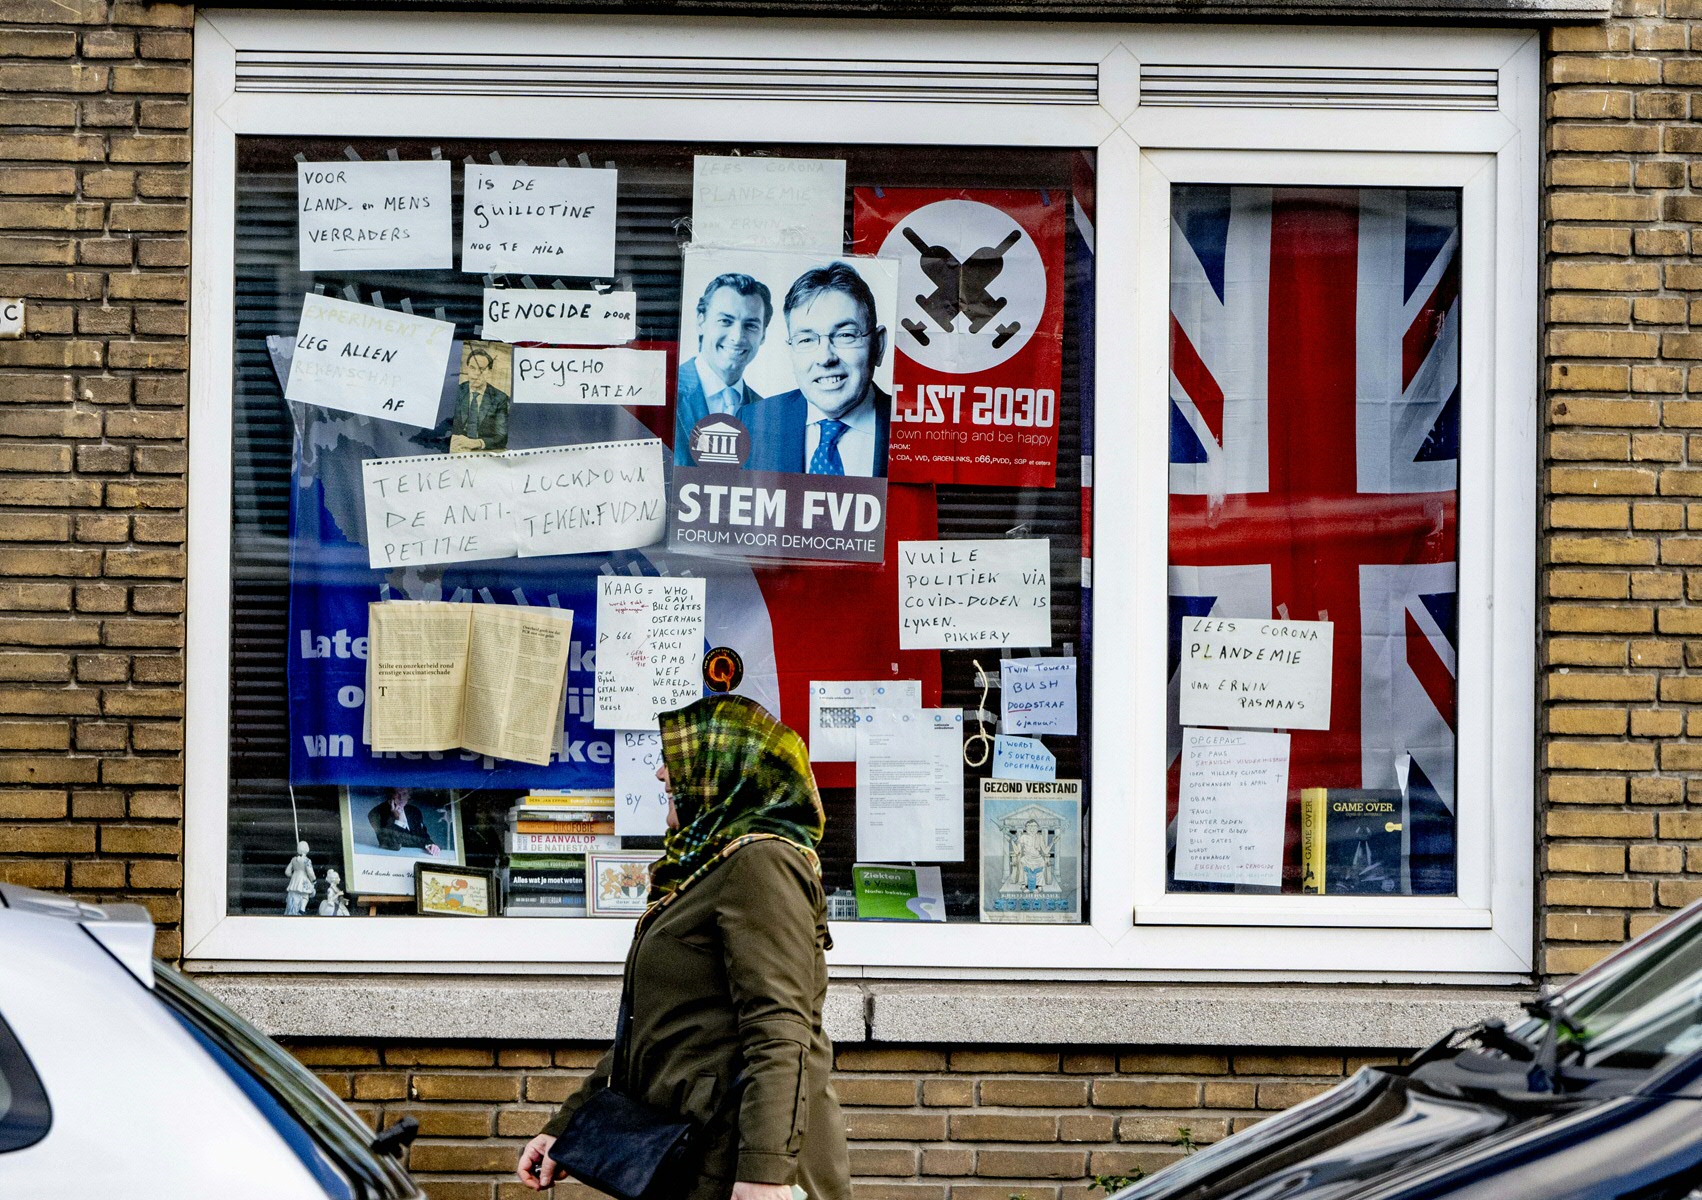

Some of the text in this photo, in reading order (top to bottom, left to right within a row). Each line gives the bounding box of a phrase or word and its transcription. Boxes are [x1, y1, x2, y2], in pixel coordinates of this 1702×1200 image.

[701, 162, 825, 177] LEES CORONA
[304, 171, 347, 184] VOOR
[512, 178, 536, 191] DE
[700, 186, 812, 203] PLANDEMIE
[384, 196, 431, 211] MENS
[308, 227, 411, 243] VERRADERS
[470, 241, 564, 256] NOG TE MILD
[488, 300, 631, 324] GENOCIDE DOOR
[303, 305, 420, 338] EXPERIMENT
[297, 333, 398, 363] LEG ALLEN
[580, 382, 642, 398] PATEN
[382, 398, 405, 412] AF
[891, 384, 1055, 428] IJST 2030
[896, 430, 922, 441] own
[925, 430, 968, 443] nothing
[971, 431, 995, 442] and
[998, 431, 1014, 442] be
[1017, 432, 1053, 446] happy
[373, 468, 477, 497] TEKEN
[677, 483, 882, 533] STEM FVD
[385, 511, 426, 528] DE
[677, 529, 876, 552] FORUM VOOR DEMOCRATIE
[385, 536, 478, 563] PETITIE
[905, 547, 978, 564] VUILE
[907, 568, 1000, 588] POLITIEK
[604, 581, 688, 596] KAAG WHO
[652, 602, 702, 611] BILL GATES
[1033, 597, 1046, 608] IS
[651, 615, 702, 623] OSTERHAUS
[944, 630, 1010, 643] PIKKERY
[1193, 620, 1318, 640] LEES CORONA
[300, 629, 369, 659] Late
[650, 642, 682, 650] FAUCI
[1191, 643, 1302, 664] PLANDEMIE
[656, 667, 681, 676] WEF
[709, 655, 735, 692] Q
[1005, 666, 1029, 674] TWIN
[378, 686, 388, 697] T
[1013, 680, 1058, 693] BUSH
[1218, 680, 1269, 692] ERWIN
[1007, 701, 1065, 710] DOODSTRAF
[1238, 696, 1305, 710] PASMANS
[1023, 716, 1058, 729] januari
[303, 733, 354, 757] van
[1190, 737, 1242, 745] OPGEPAKT
[1015, 753, 1051, 761] OKTOBER
[984, 782, 1078, 794] GEZOND VERSTAND
[625, 793, 641, 814] BY
[1333, 803, 1364, 812] GAME
[553, 823, 594, 832] OIKOFOBIE
[544, 844, 600, 852] NATIESTAAT
[513, 876, 528, 884] Alles
[541, 876, 547, 885] je
[863, 872, 901, 880] Ziekten
